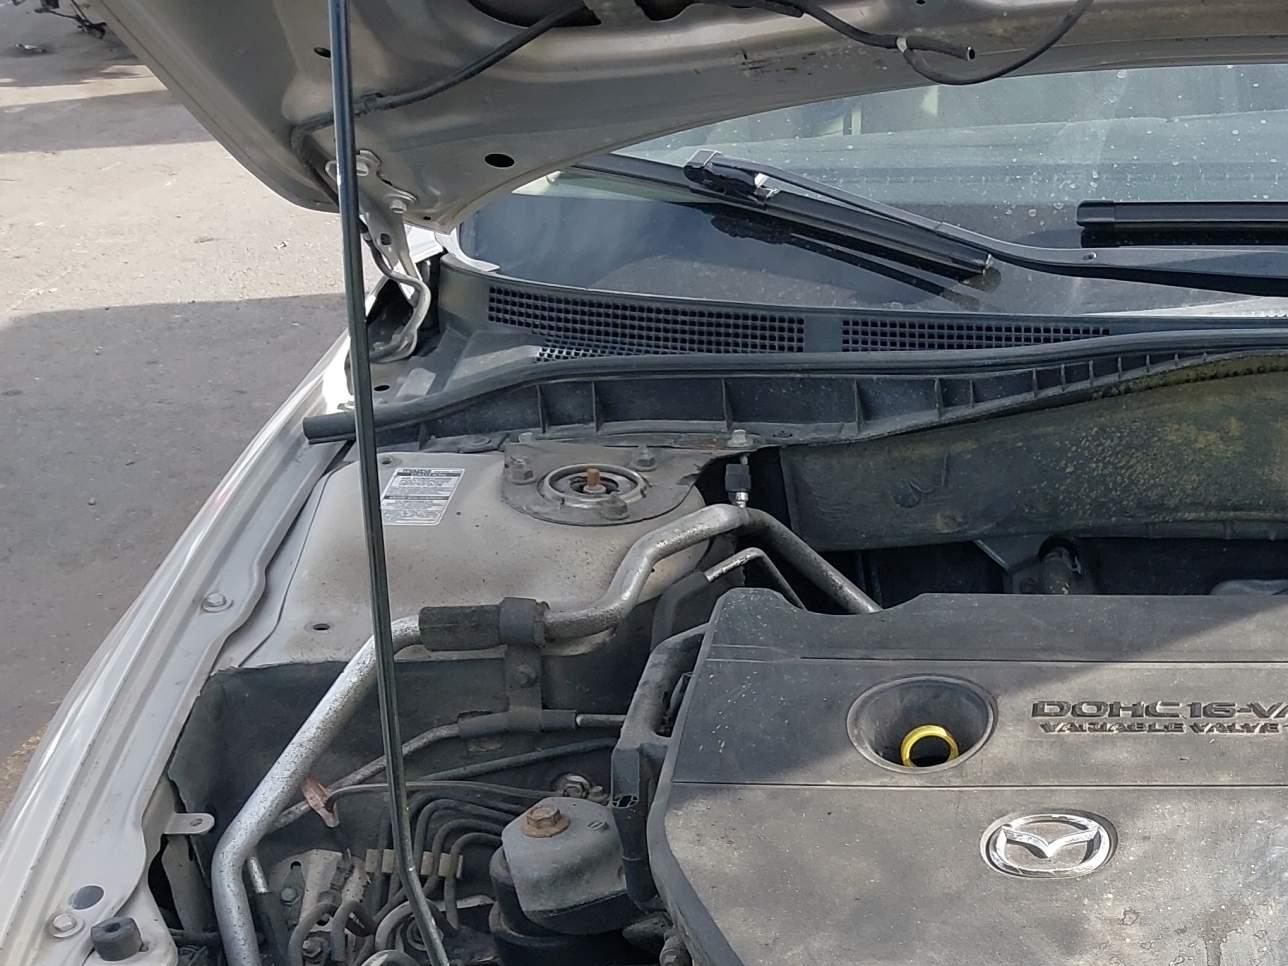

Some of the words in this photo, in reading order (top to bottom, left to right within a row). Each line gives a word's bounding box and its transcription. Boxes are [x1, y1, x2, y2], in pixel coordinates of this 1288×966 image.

[1031, 700, 1182, 718] DOHC
[1040, 721, 1185, 733] VARIABLE
[1189, 721, 1280, 733] VALVE
